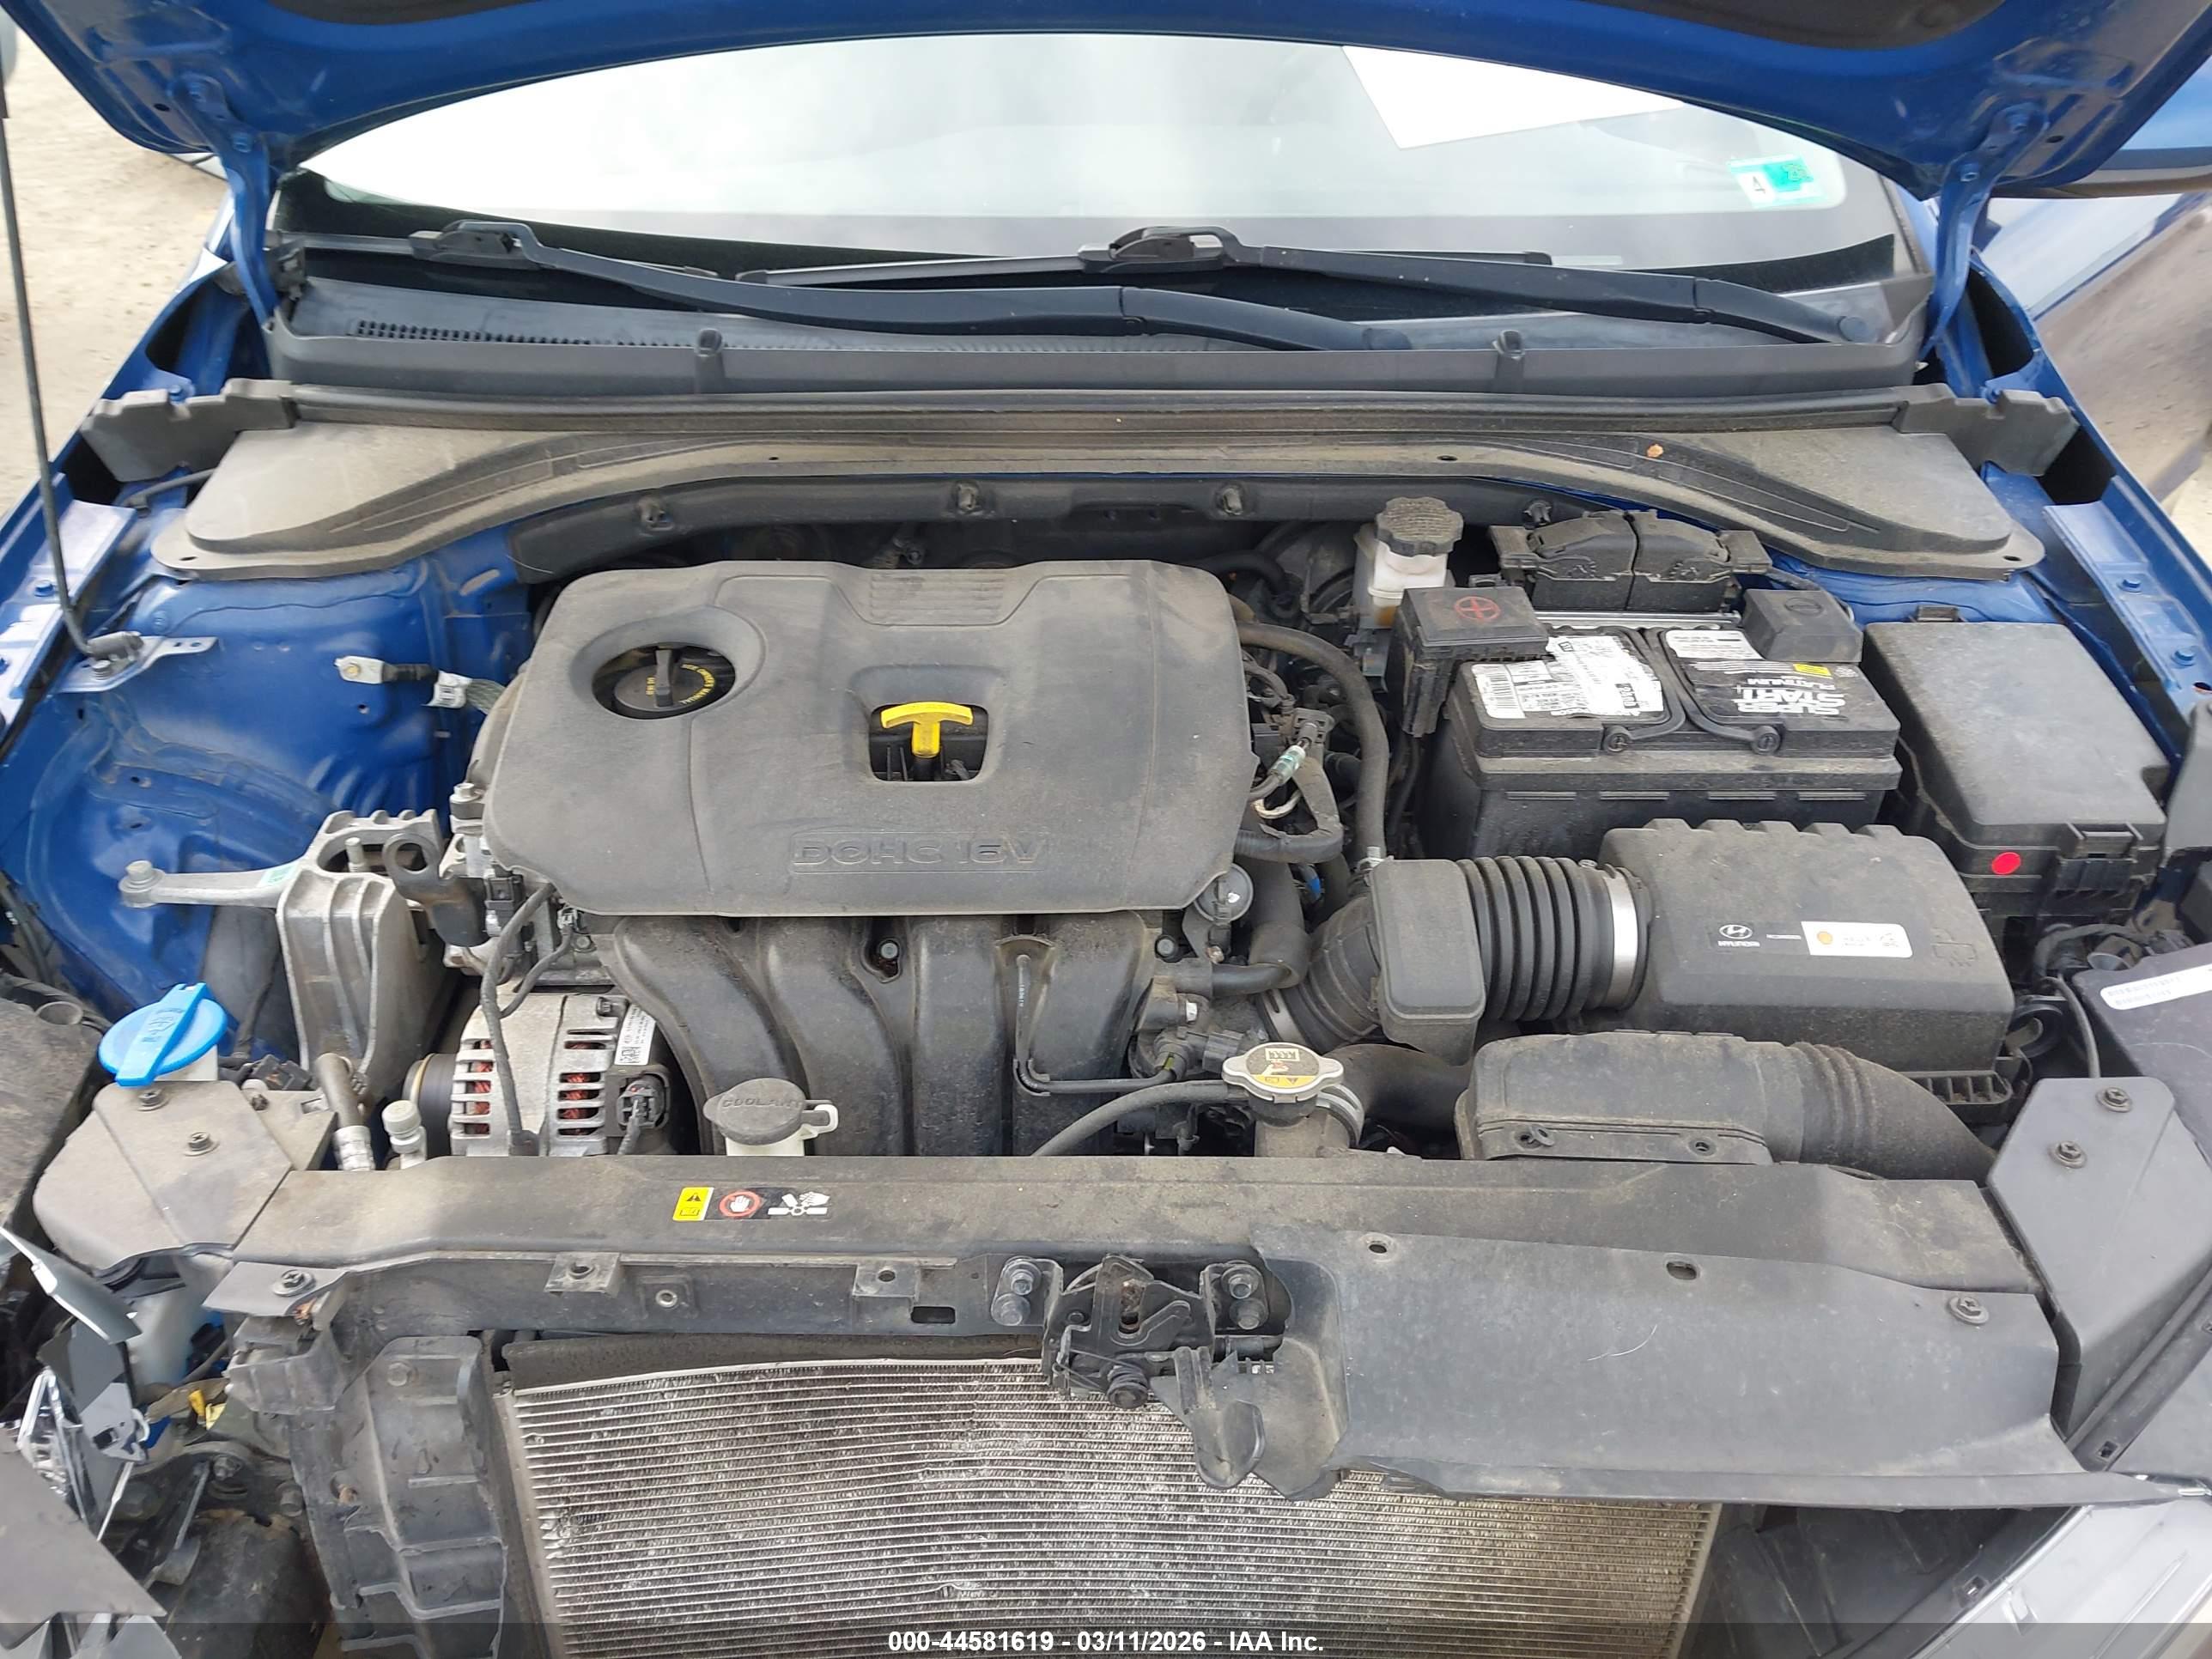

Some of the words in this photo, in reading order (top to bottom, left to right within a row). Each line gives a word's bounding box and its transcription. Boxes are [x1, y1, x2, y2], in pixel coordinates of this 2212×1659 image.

[1738, 688, 1846, 708] START
[1737, 701, 1840, 715] SUPER
[790, 839, 943, 865] DOHC
[720, 1097, 805, 1109] COOLANT
